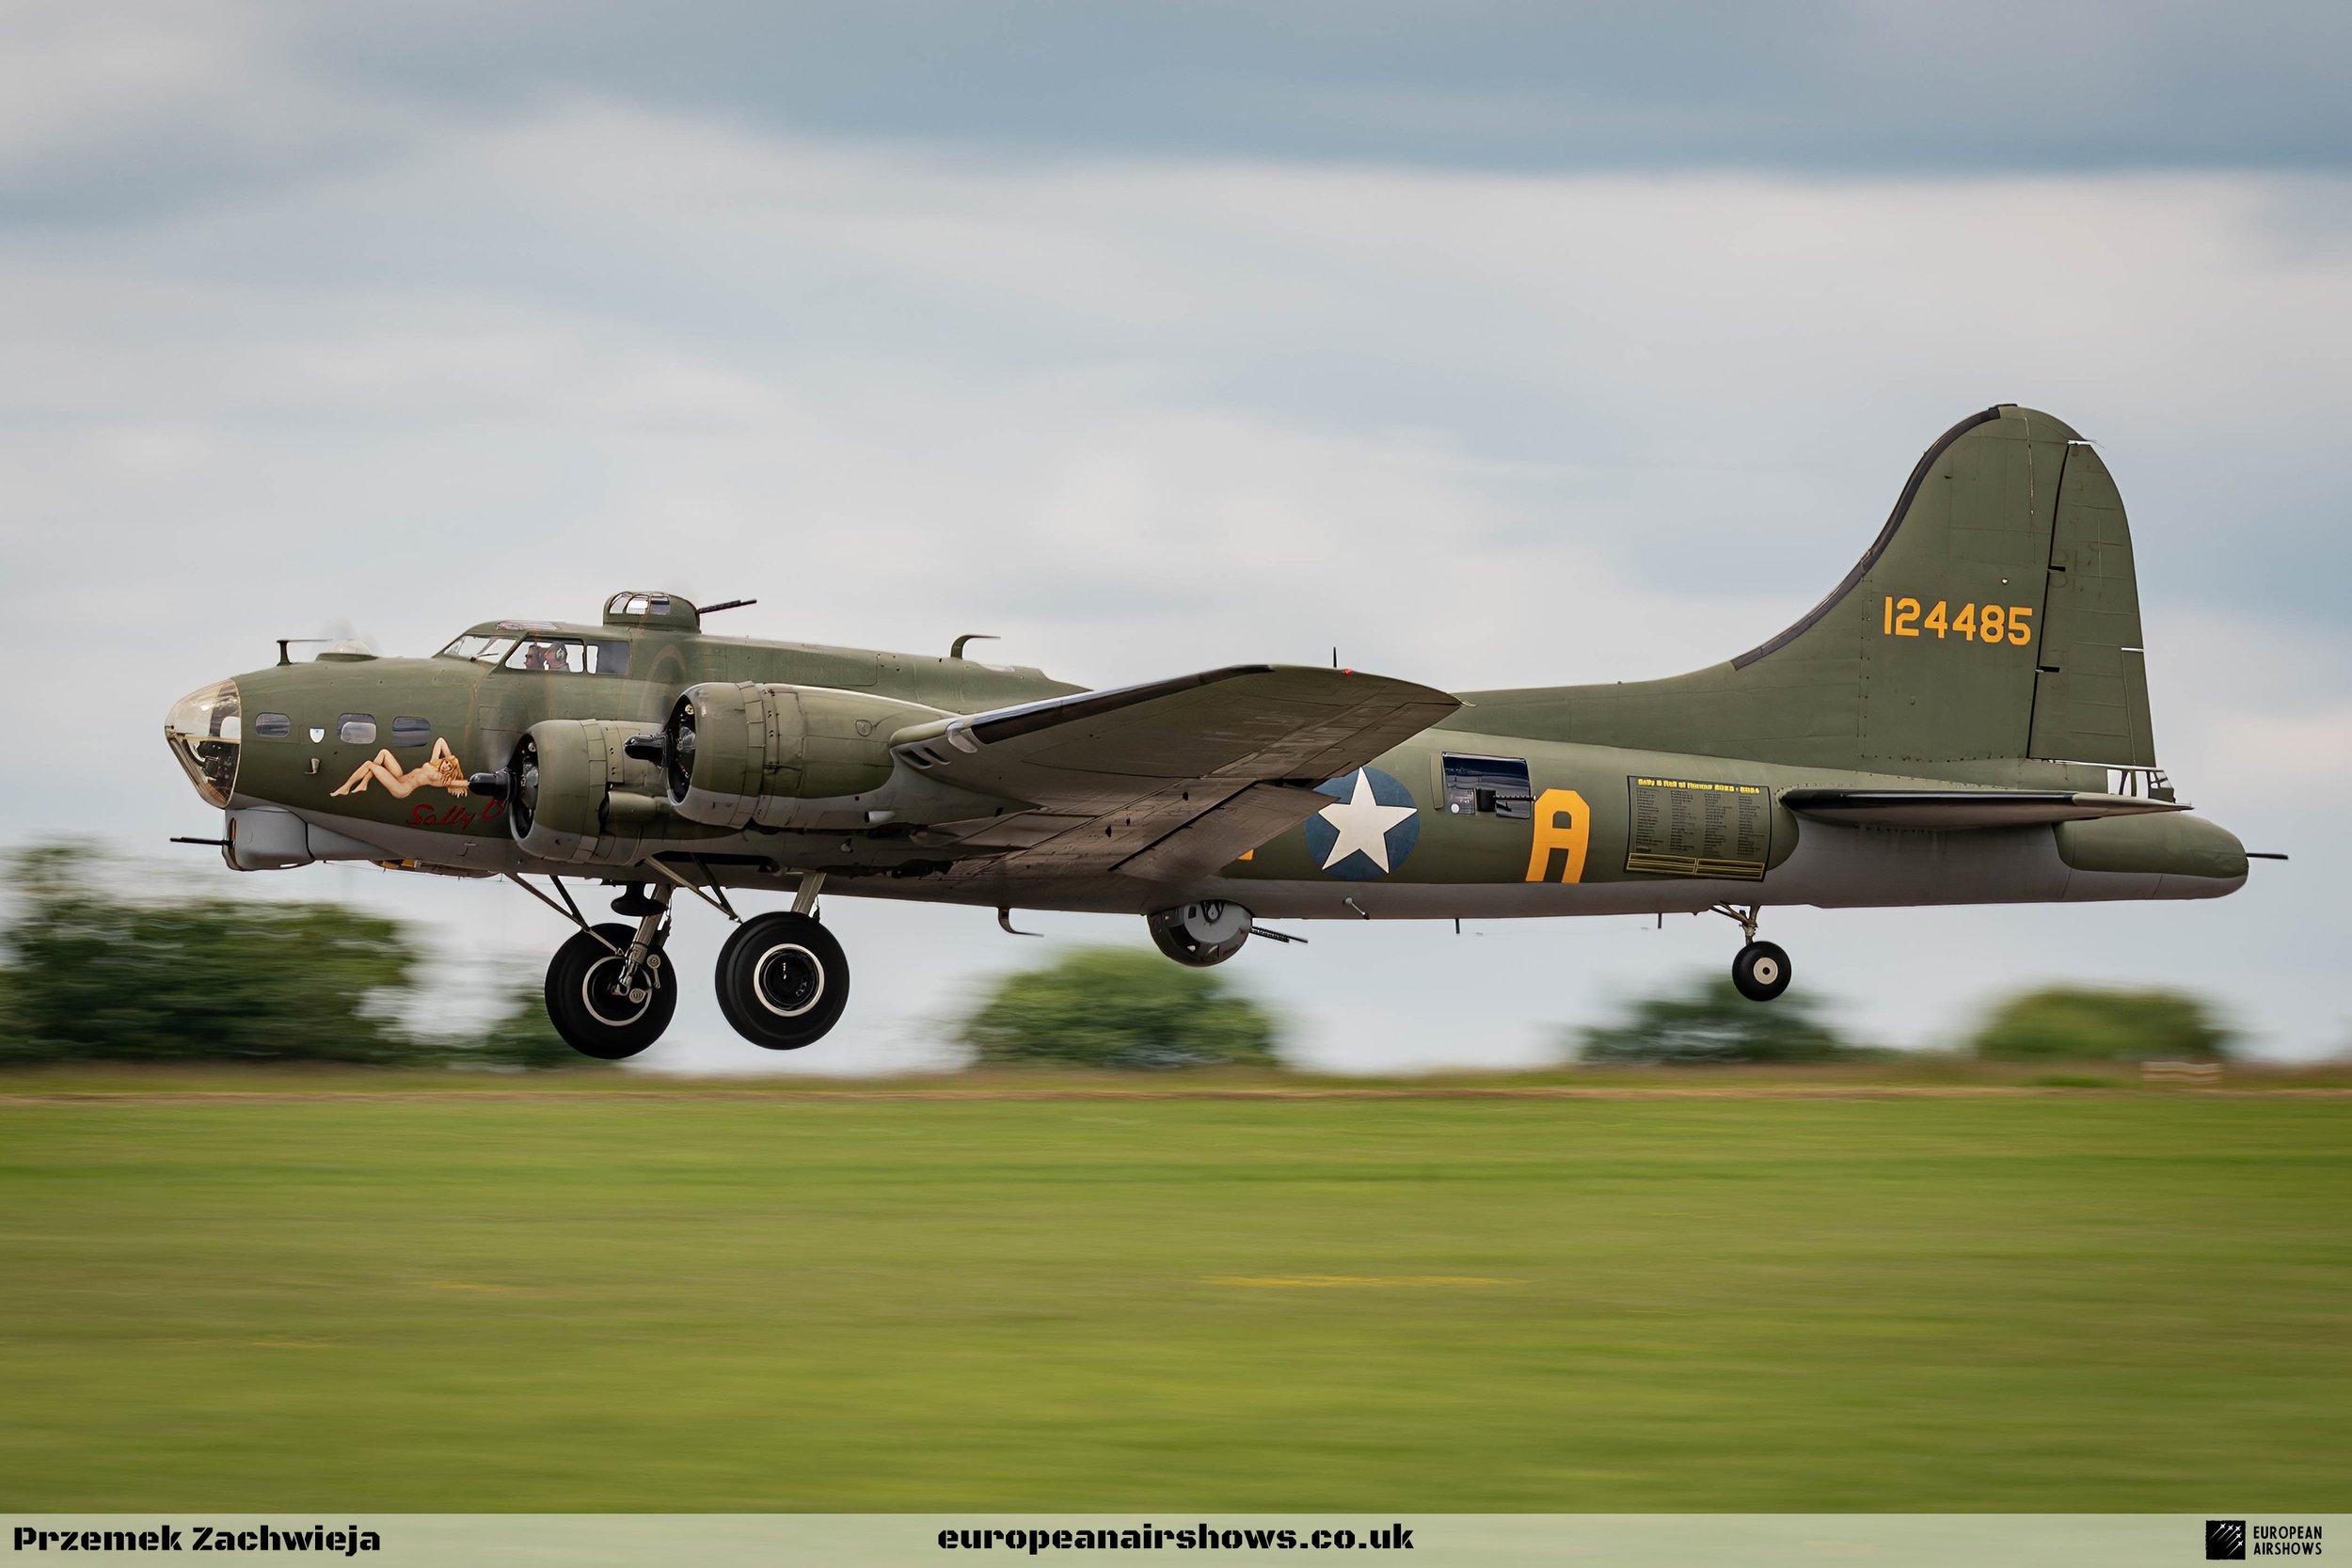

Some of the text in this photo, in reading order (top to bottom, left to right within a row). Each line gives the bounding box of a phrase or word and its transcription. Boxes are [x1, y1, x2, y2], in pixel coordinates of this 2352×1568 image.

[1883, 596, 2032, 646] 124485
[405, 803, 477, 829] Sally
[1525, 788, 1590, 883] A
